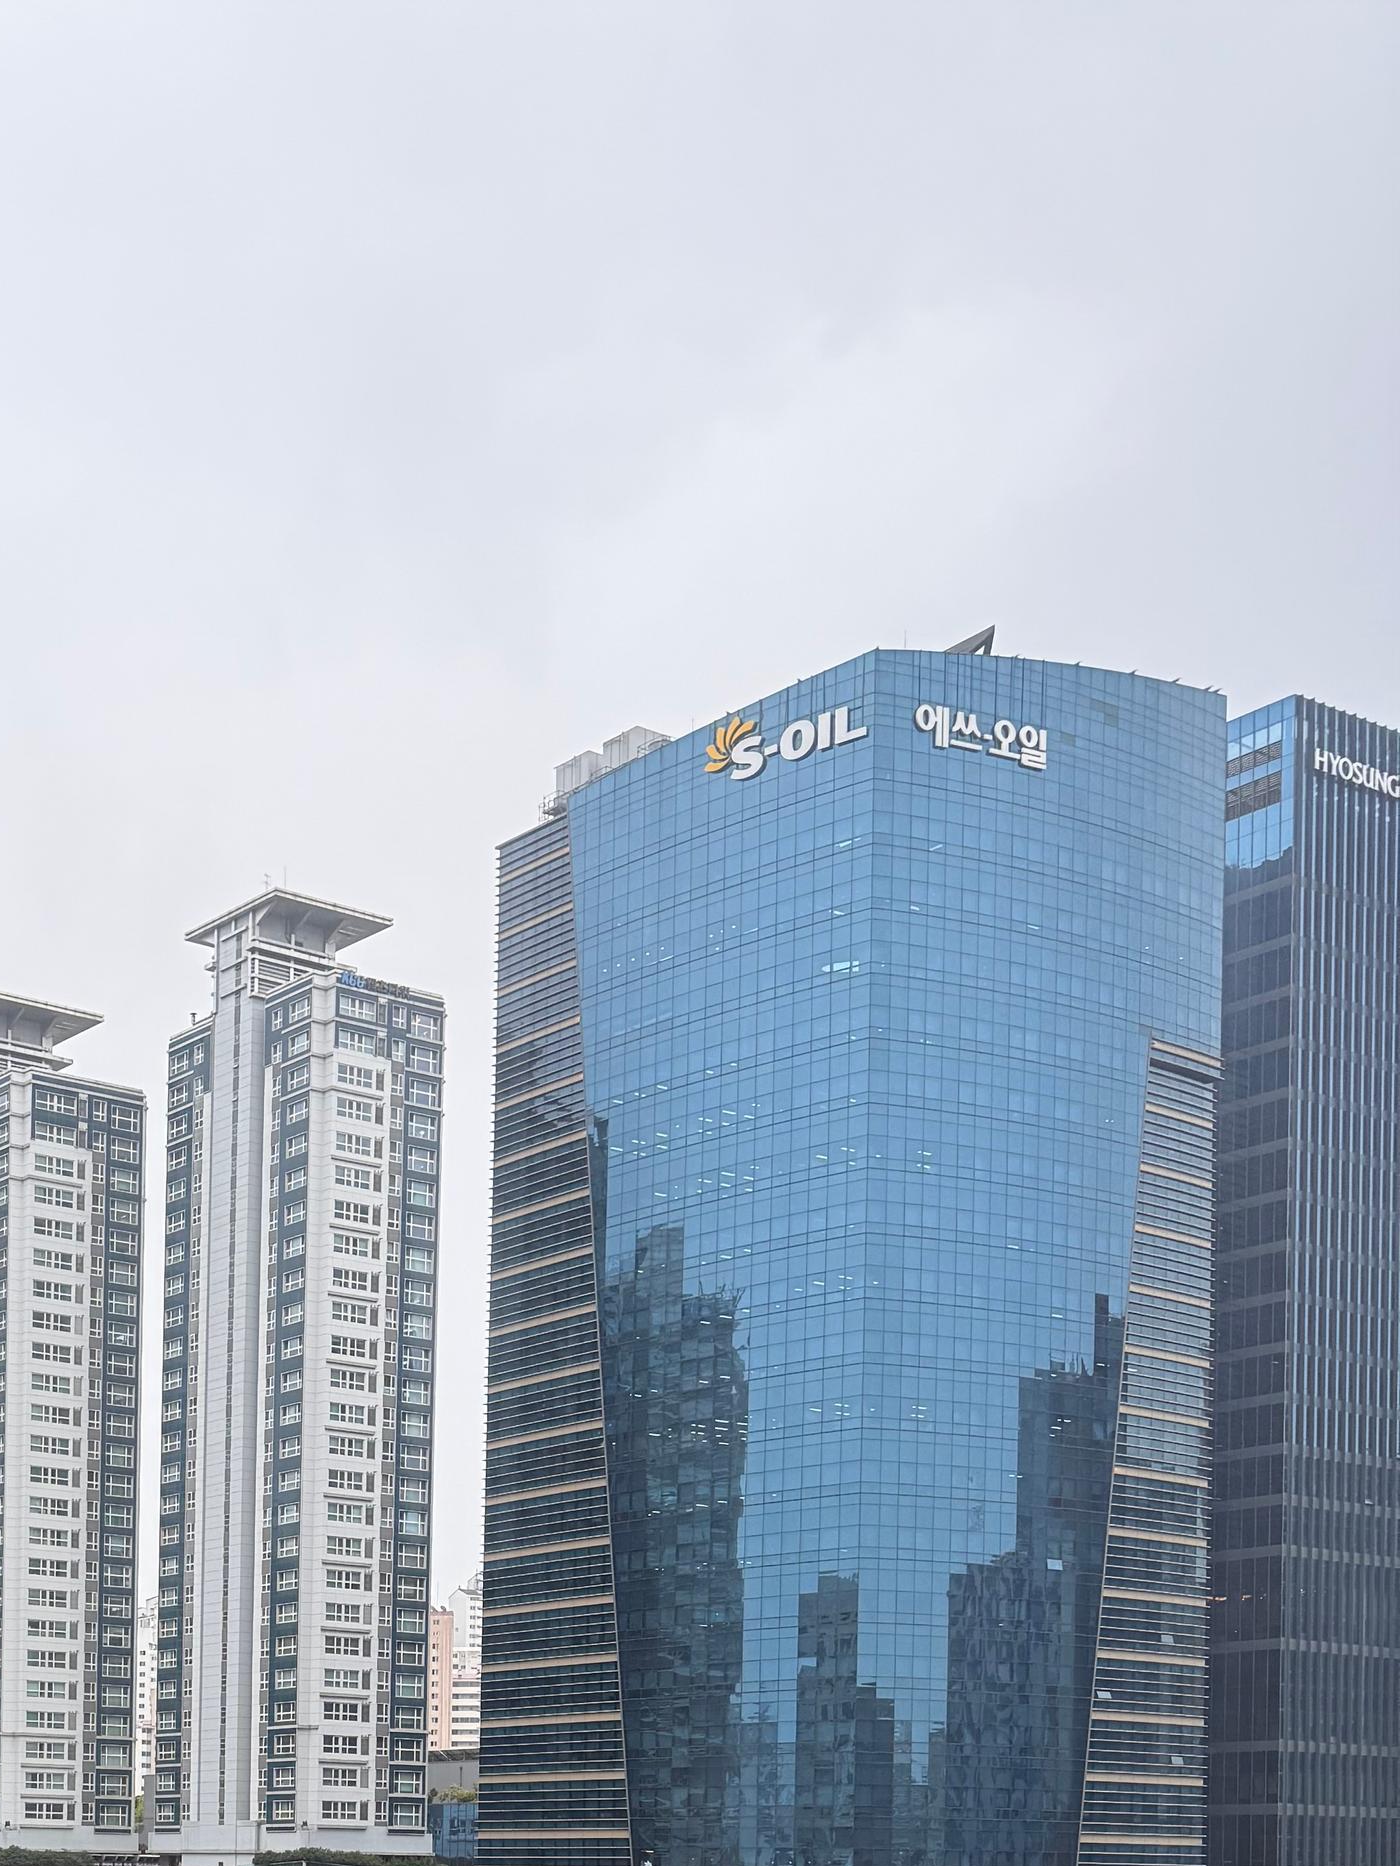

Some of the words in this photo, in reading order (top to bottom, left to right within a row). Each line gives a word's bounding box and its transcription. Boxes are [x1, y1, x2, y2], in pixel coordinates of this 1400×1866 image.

[731, 704, 868, 780] S-OIL
[913, 702, 1048, 770] 에쓰-오일
[1314, 748, 1400, 798] HYOSUNG
